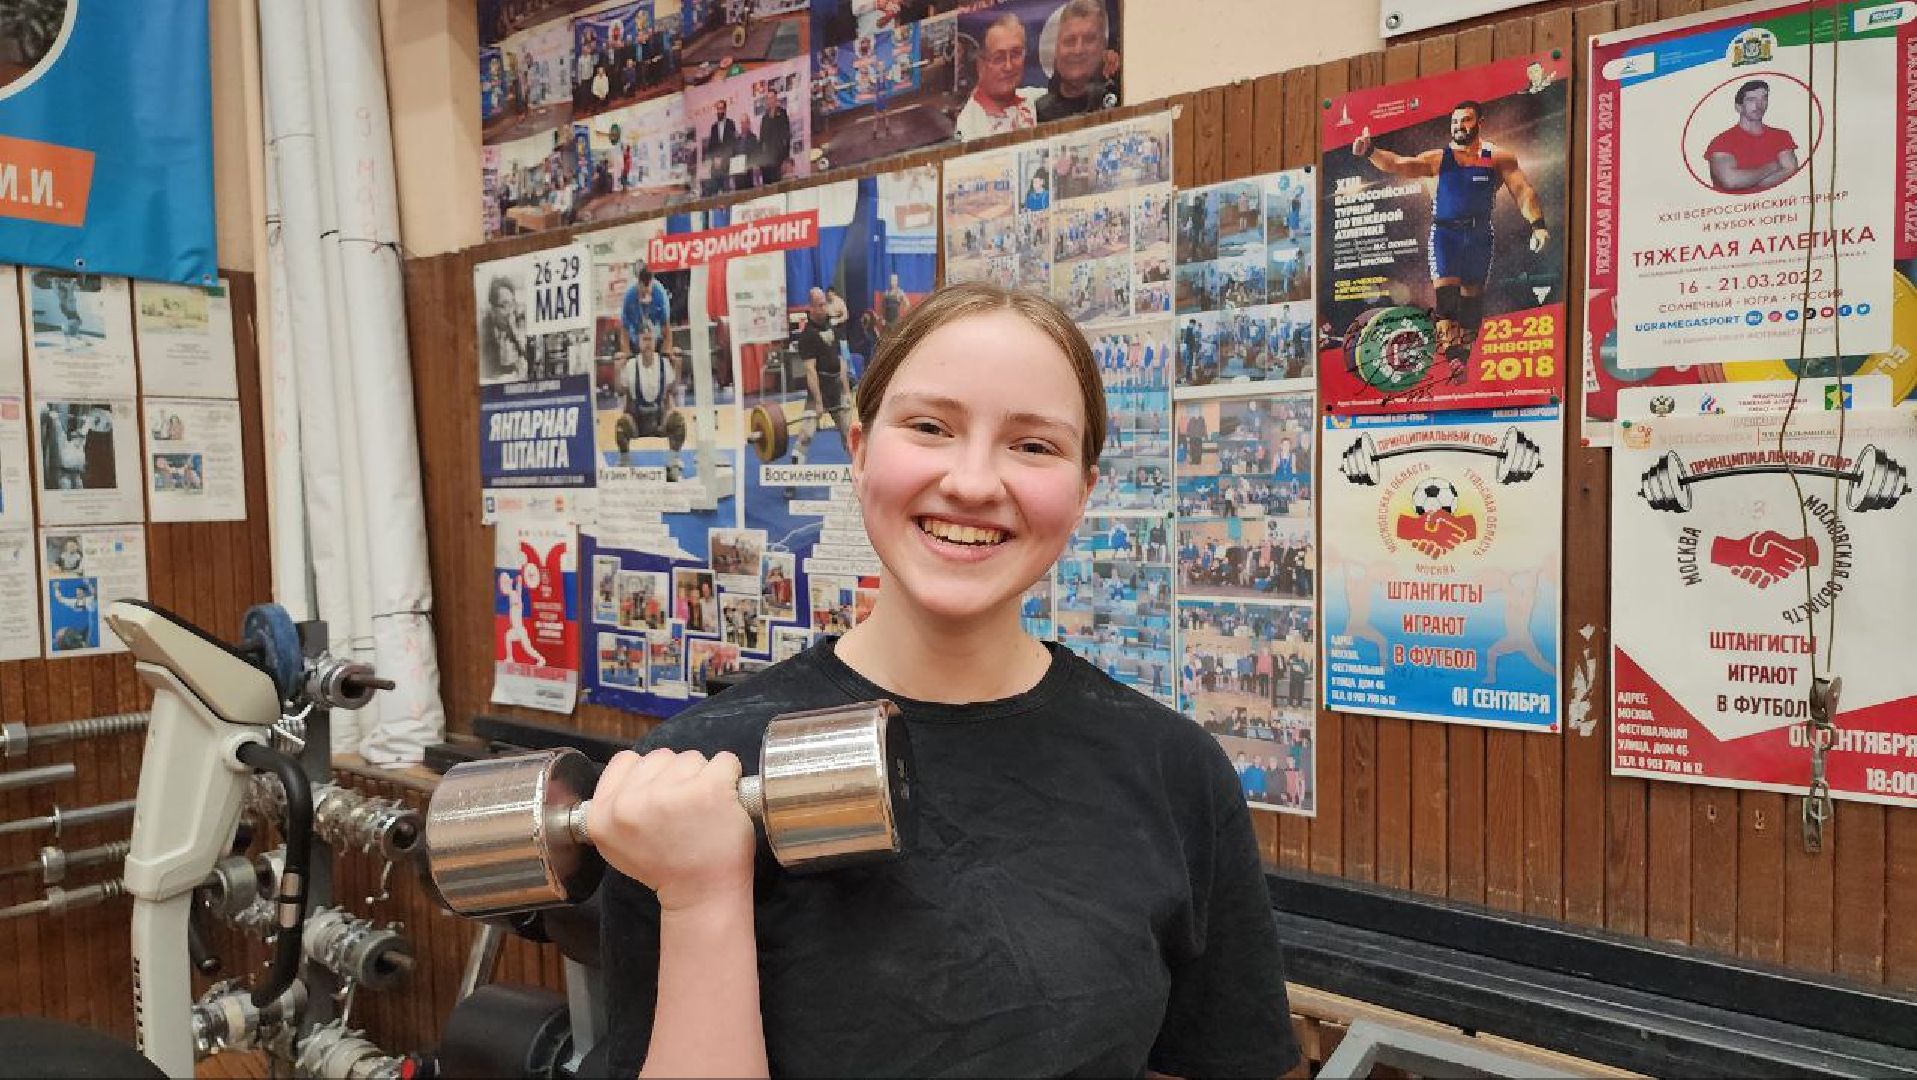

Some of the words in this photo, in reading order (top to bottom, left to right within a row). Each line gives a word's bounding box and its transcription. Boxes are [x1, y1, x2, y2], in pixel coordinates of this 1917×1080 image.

[1598, 91, 1613, 131] 2022
[1596, 133, 1612, 206] АТЛЕТИКА
[1682, 196, 1797, 221] ВСЕРОССИЙСКИЙ
[1799, 190, 1849, 206] ТУРНИР
[1335, 217, 1350, 230] ПО
[1702, 221, 1713, 233] И
[1714, 215, 1757, 232] КУБОК
[1760, 212, 1799, 226] ЮГРЫ
[649, 217, 812, 264] Пауэрлифтинг
[1596, 208, 1612, 276] ТЯЖЕЛАЯ
[1632, 239, 1740, 268] ТЯЖЕЛАЯ
[1749, 225, 1876, 255] АТЛЕТИКА
[1678, 279, 1699, 295] 16
[1718, 268, 1824, 291] 21.03.2022
[534, 287, 580, 323] МАЯ
[1658, 298, 1733, 315] СОЛНЕЧНЫЙ
[1743, 294, 1779, 307] ЮГРА
[1789, 288, 1844, 302] РОССИЯ
[1483, 315, 1555, 342] 23-28
[1635, 315, 1741, 332] UGRAMEGASPORT
[1481, 337, 1554, 355] января
[1480, 355, 1555, 382] 2018
[488, 407, 580, 442] ЯНТАРНАЯ
[1376, 430, 1470, 451] ПРИНЦИПИАЛЬНЫЙ
[1472, 432, 1498, 447] СПОР
[501, 438, 570, 471] ШТАНГА
[1689, 450, 1814, 474] ПРИНЦИПИАЛЬНЫЙ
[1818, 453, 1853, 471] СПОР
[765, 466, 838, 482] Василенко
[1803, 494, 1853, 579] МОСКОВСКАЯ
[1677, 526, 1703, 586] МОСКВА
[1387, 580, 1483, 604] ШТАНГИСТЫ
[1782, 580, 1844, 624] ОБЛАСТЬ
[1402, 613, 1467, 636] ИГРАЮТ
[1709, 630, 1817, 655] ШТАНГИСТЫ
[1393, 644, 1405, 666] В
[1408, 645, 1477, 671] ФУТБОЛ
[1727, 664, 1798, 686] ИГРАЮТ
[1451, 686, 1468, 707] 01
[1472, 688, 1551, 715] СЕНТЯБРЯ
[1618, 691, 1648, 704] АДРЕС:
[1716, 694, 1728, 712] В
[1733, 694, 1808, 718] ФУТБОЛ
[1618, 723, 1688, 739] ФЕСТИВАЛЬНАЯ
[1652, 742, 1675, 755] ДОМ
[1866, 767, 1917, 796] 18:00
